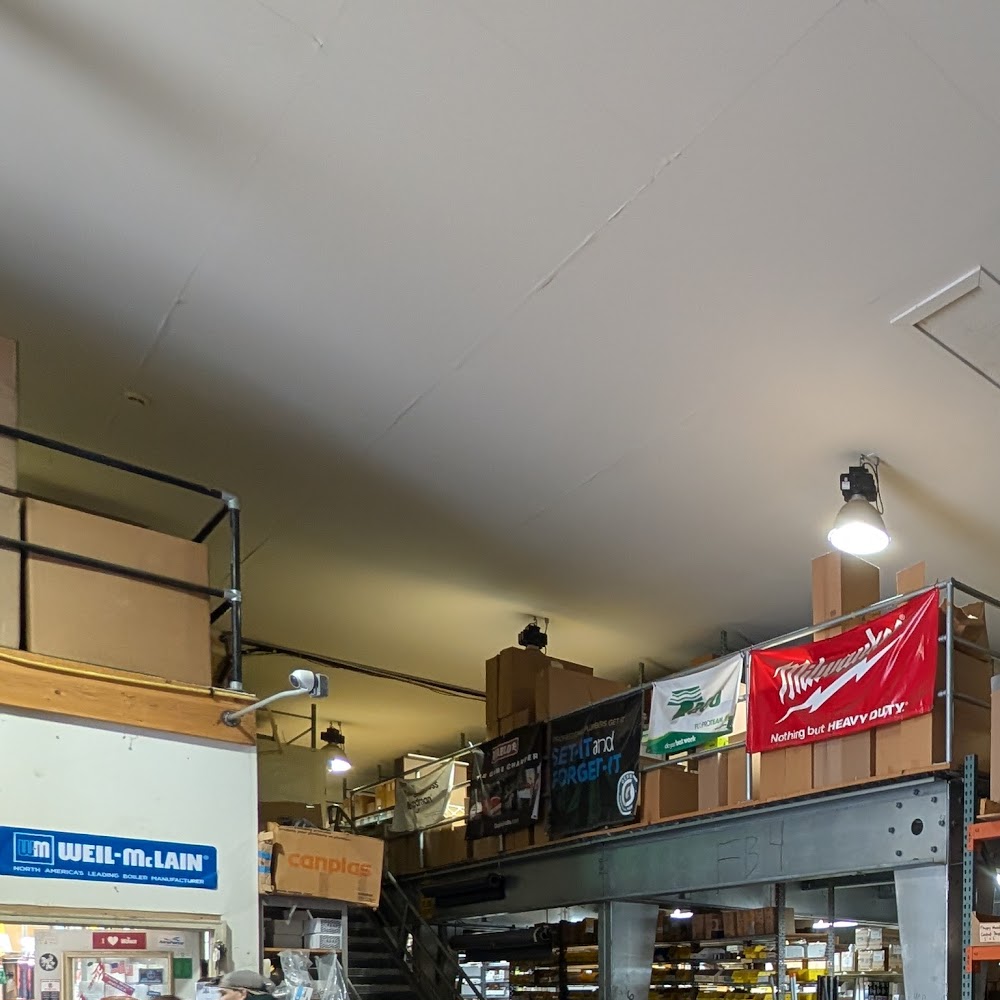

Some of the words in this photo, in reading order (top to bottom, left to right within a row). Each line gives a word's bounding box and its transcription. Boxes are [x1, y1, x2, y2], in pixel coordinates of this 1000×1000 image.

[770, 728, 805, 743] Nothing
[807, 725, 825, 737] but
[827, 713, 868, 732] HEAVY
[593, 730, 615, 755] and
[13, 865, 41, 873] NORTH
[44, 867, 85, 876] AMERICA'S
[87, 870, 120, 878] LEADING
[122, 873, 148, 881] BOILER
[150, 875, 205, 885] MANUFACTURER
[287, 853, 372, 877] canplas
